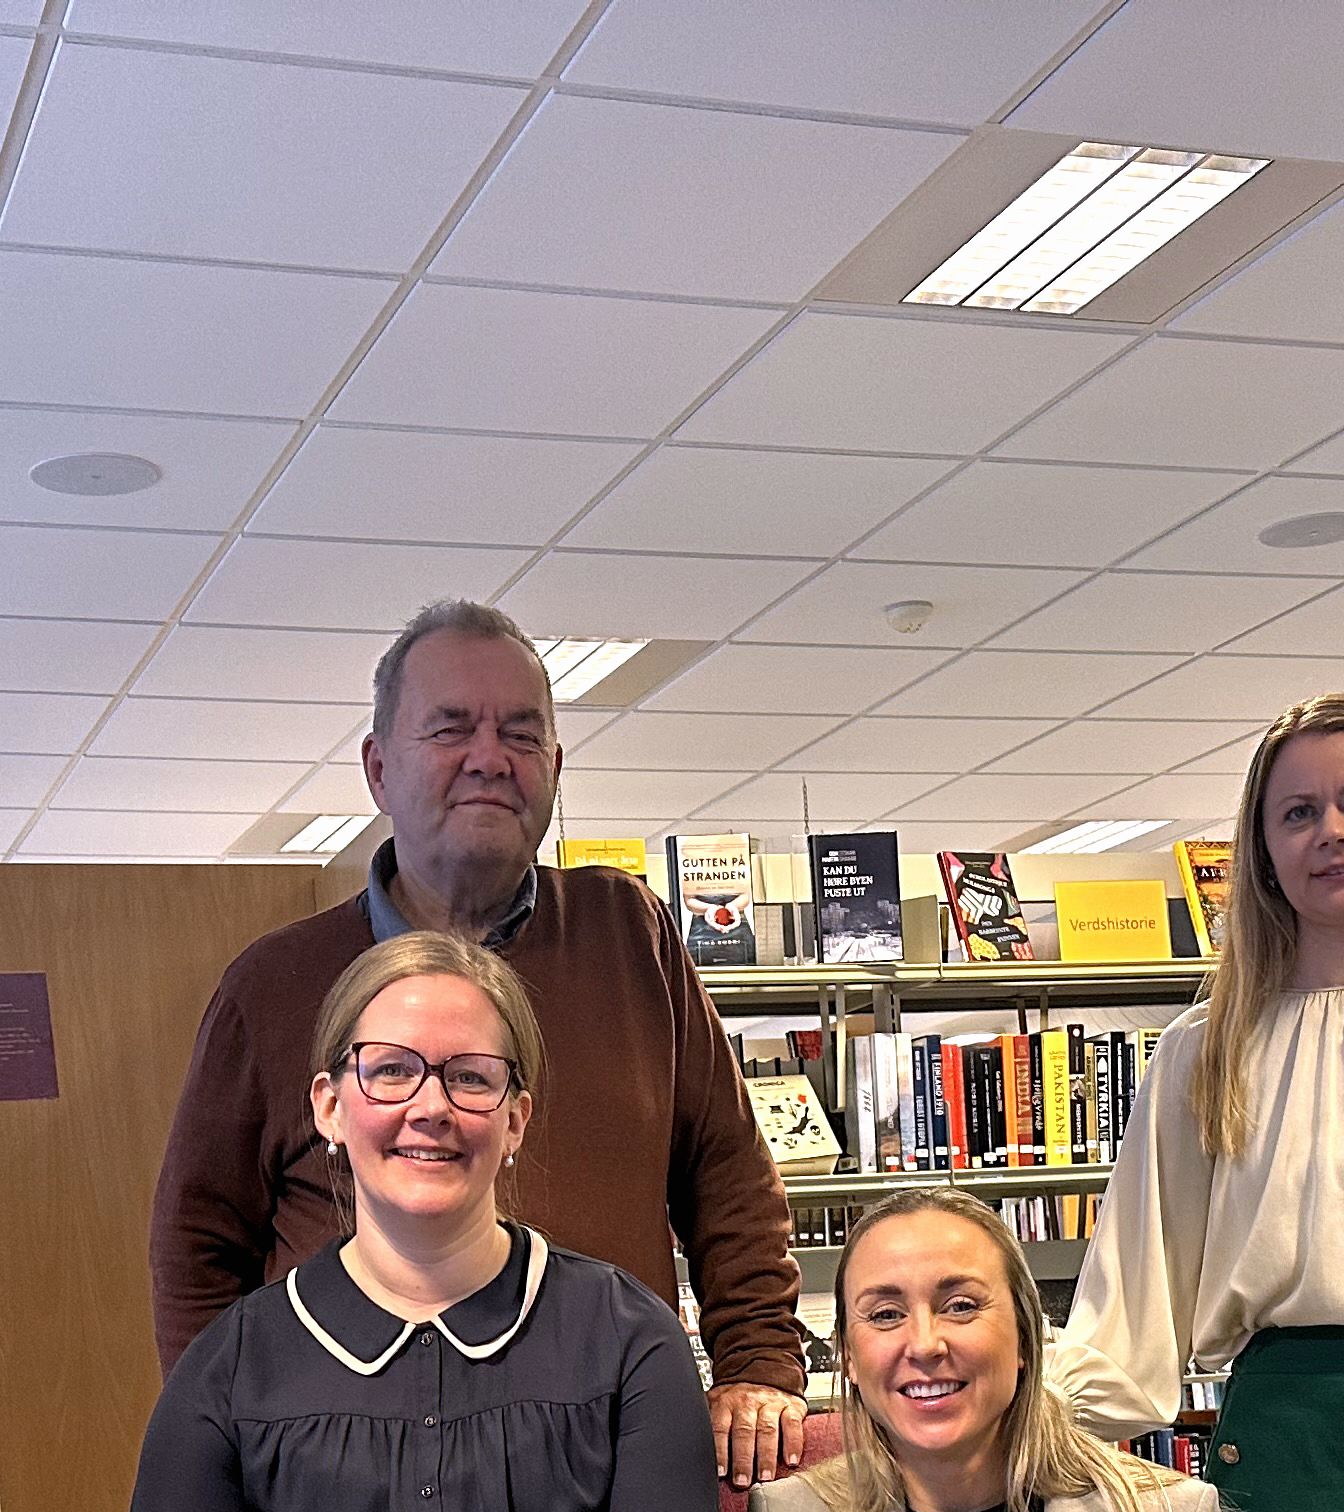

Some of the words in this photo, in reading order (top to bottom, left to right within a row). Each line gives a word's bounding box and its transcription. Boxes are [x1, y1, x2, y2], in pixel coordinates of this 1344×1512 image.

[682, 857, 727, 868] GUTTEN
[731, 853, 746, 867] PÅ
[683, 871, 746, 882] STRANDEN
[823, 865, 843, 876] KAN
[844, 865, 858, 875] DU
[850, 875, 874, 886] BYEN
[824, 887, 853, 898] PUSTE
[853, 886, 866, 896] UT
[1068, 917, 1157, 931] Verdshistorie
[1016, 1063, 1032, 1116] INDIA
[1053, 1064, 1066, 1135] PAKISTAN
[1098, 1074, 1110, 1129] TYRKIA
